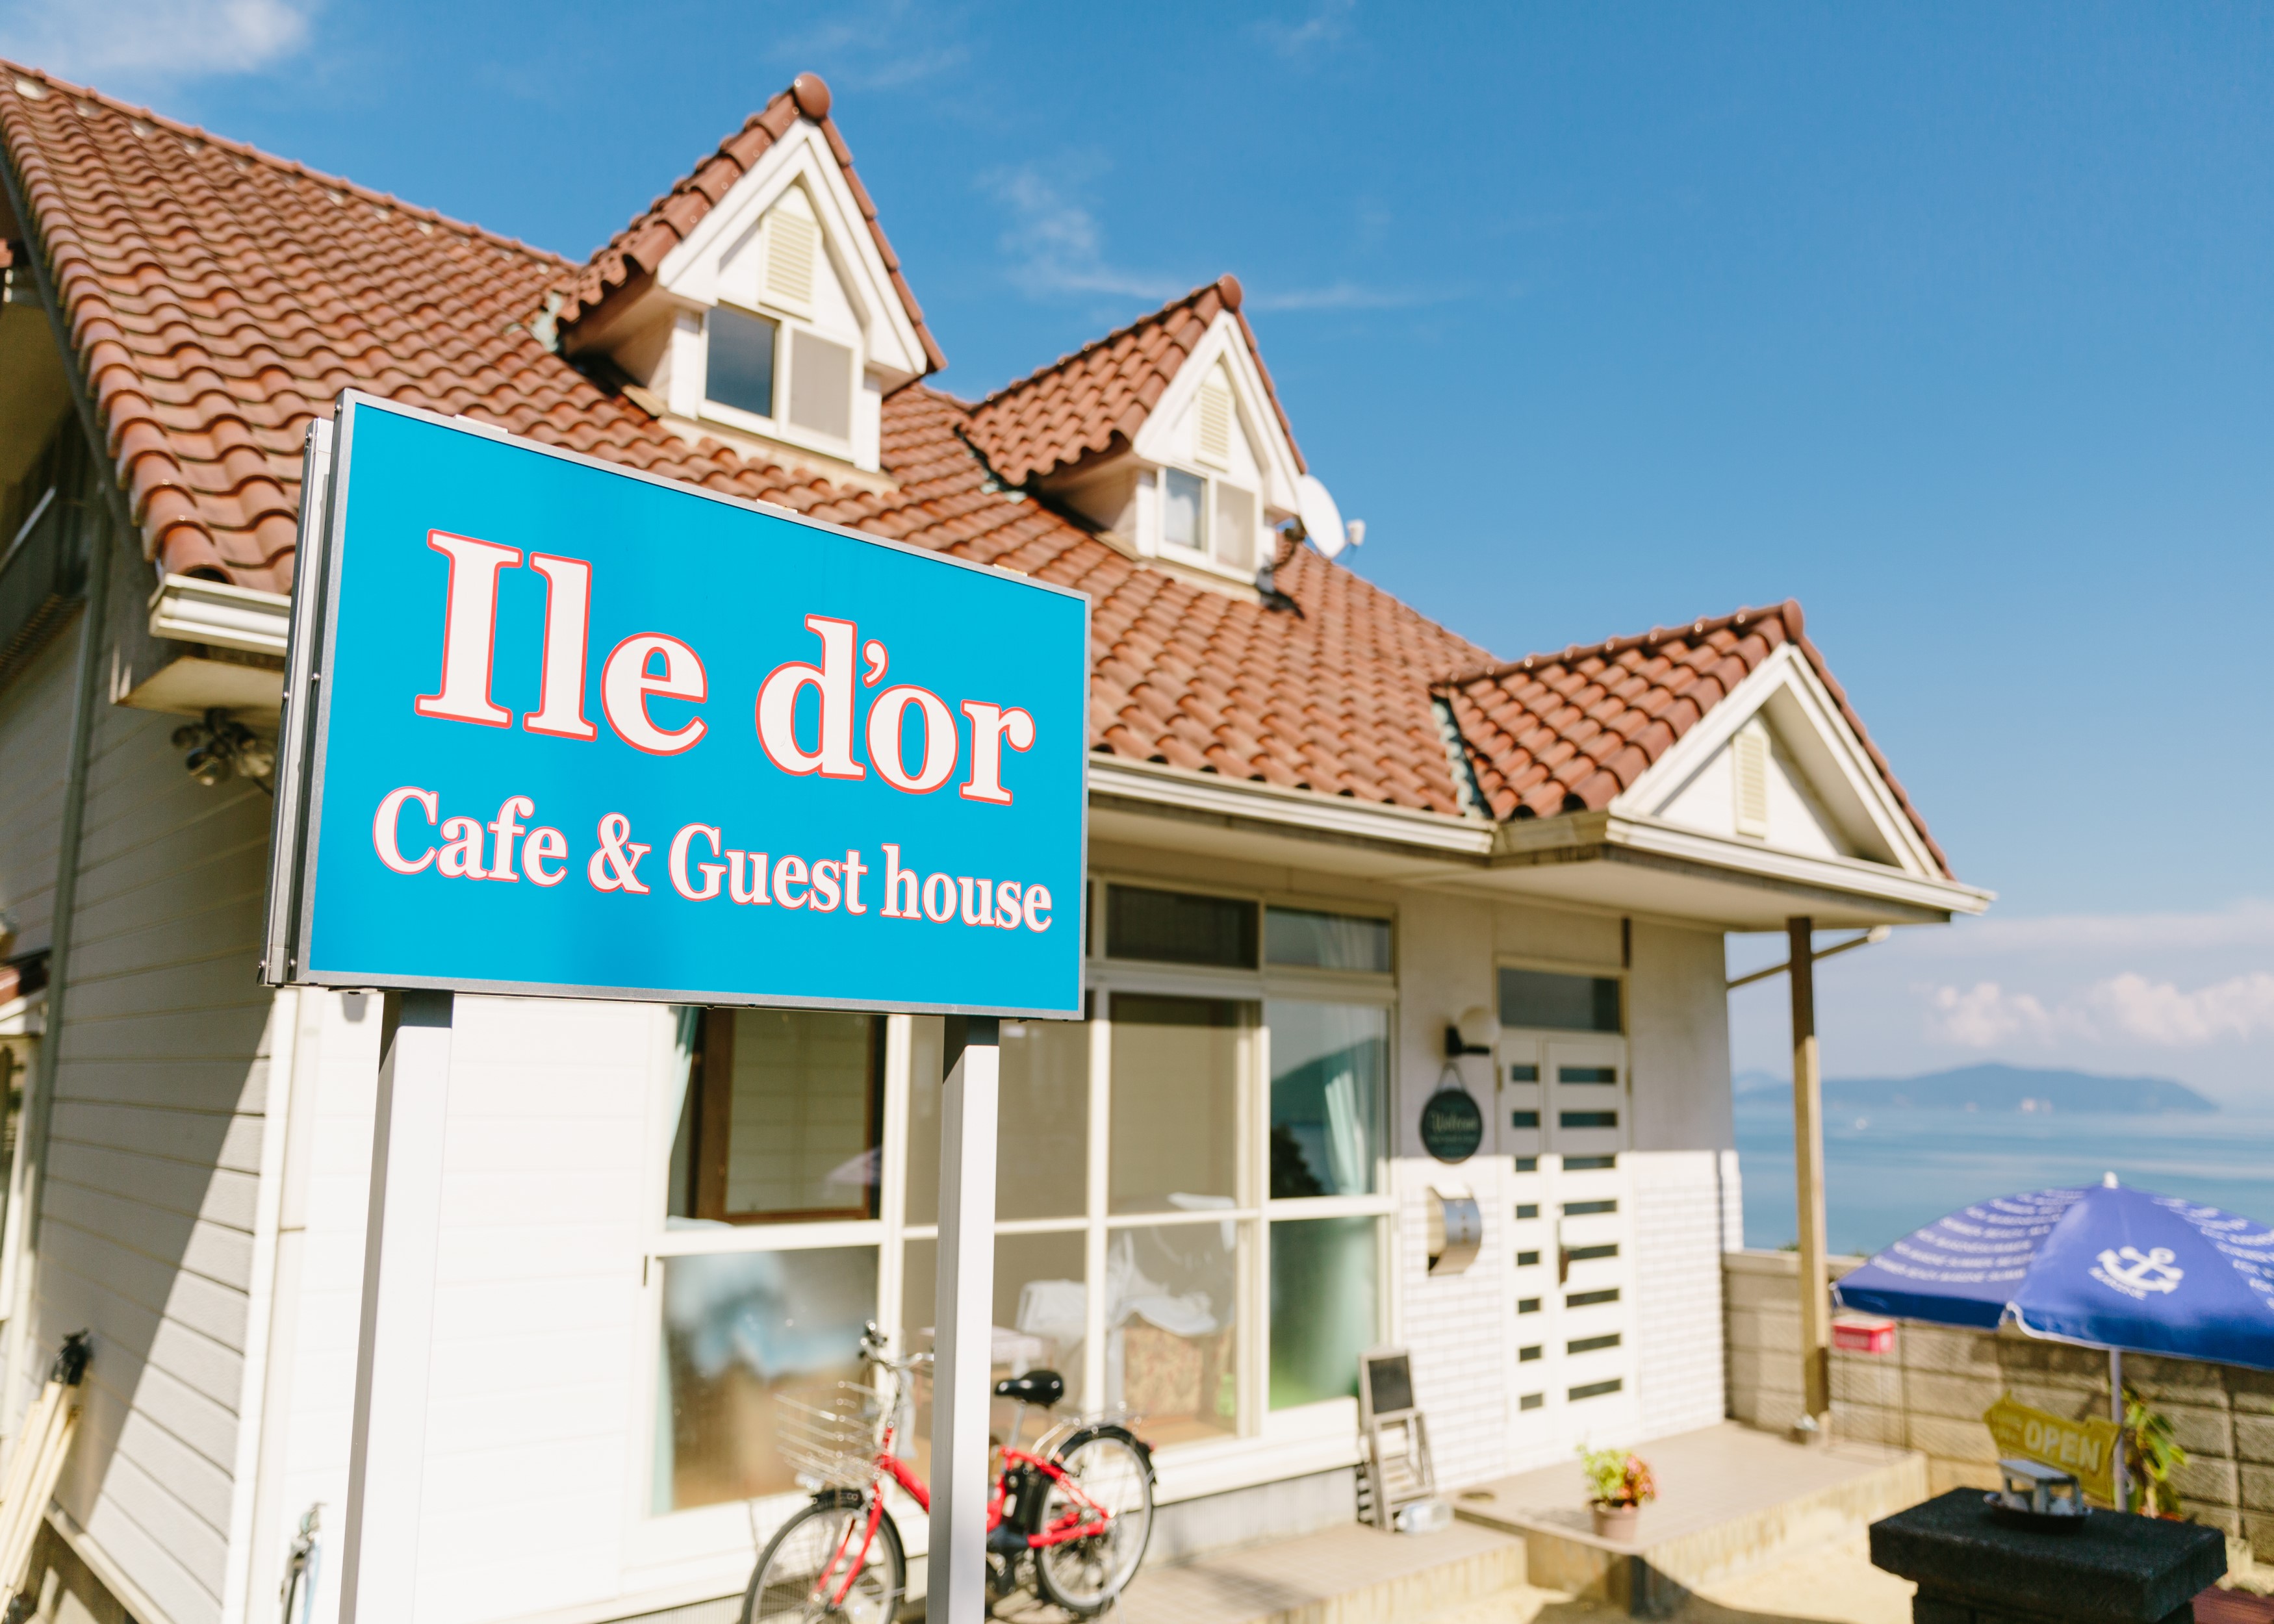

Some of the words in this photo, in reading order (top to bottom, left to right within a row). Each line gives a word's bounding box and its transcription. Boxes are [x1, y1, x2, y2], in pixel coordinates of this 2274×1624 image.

[415, 529, 709, 757] Ile
[755, 613, 1036, 807] d'or
[373, 786, 568, 887] Cafe
[587, 812, 652, 896] &
[669, 822, 869, 916] Guest
[880, 843, 1053, 933] house
[2024, 1419, 2101, 1472] OPEN
